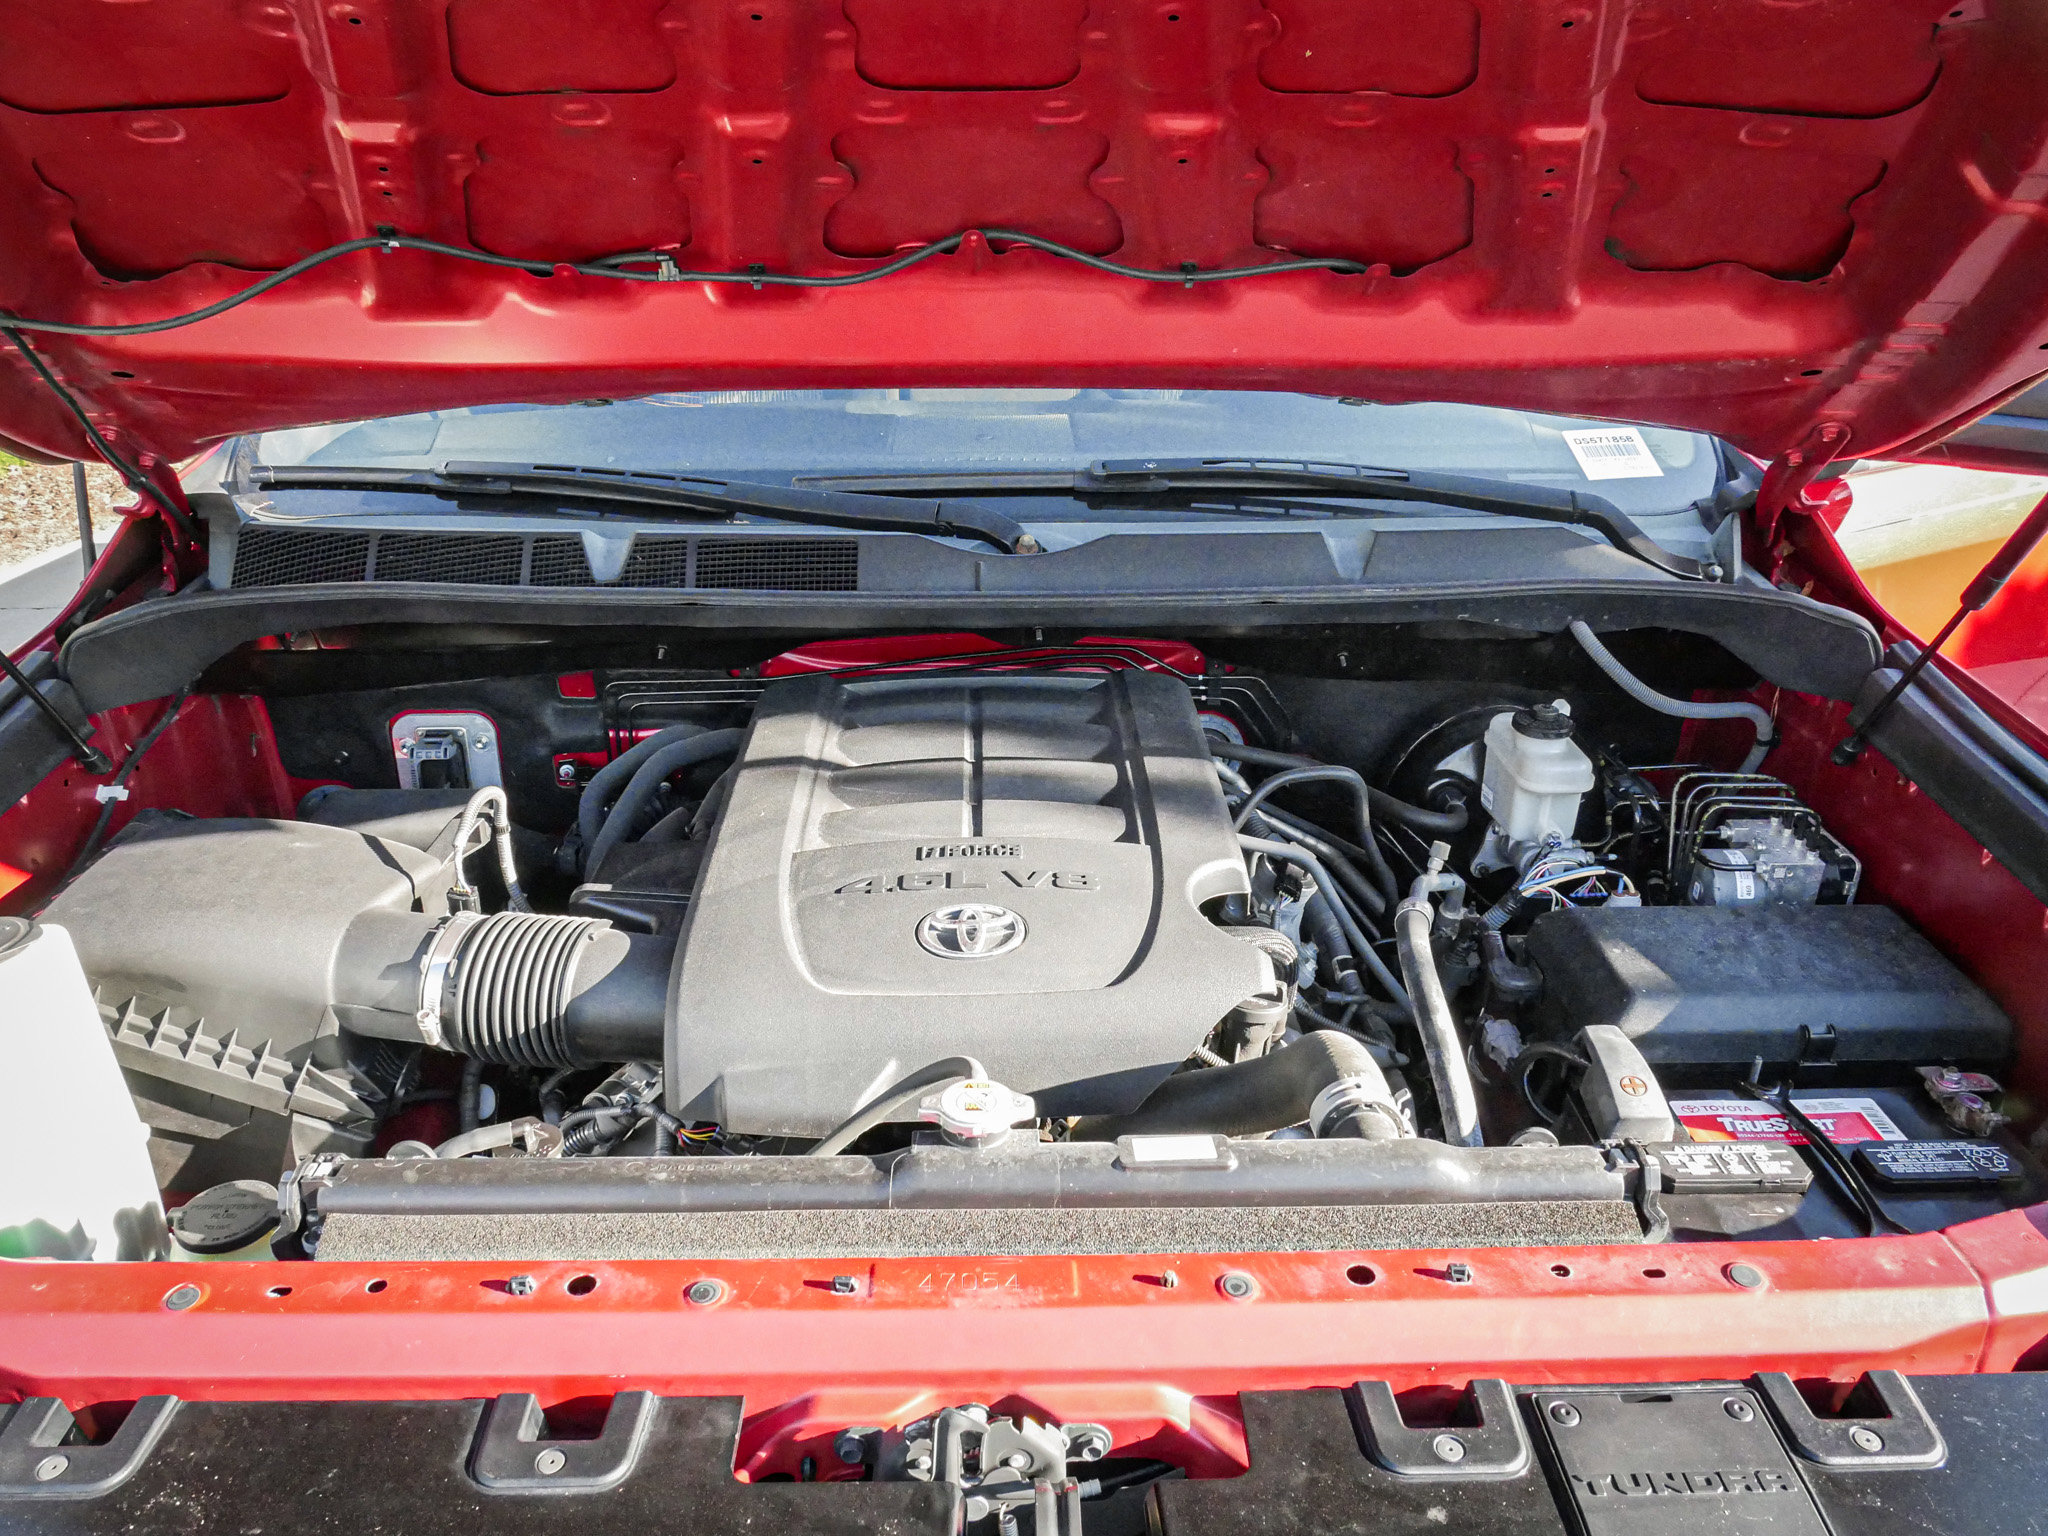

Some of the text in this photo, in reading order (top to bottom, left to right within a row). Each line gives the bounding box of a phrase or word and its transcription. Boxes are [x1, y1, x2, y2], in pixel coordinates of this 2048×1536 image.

[1000, 869, 1100, 890] V8
[918, 1272, 1022, 1293] 47054
[1571, 1468, 1798, 1497] TUNDRA
